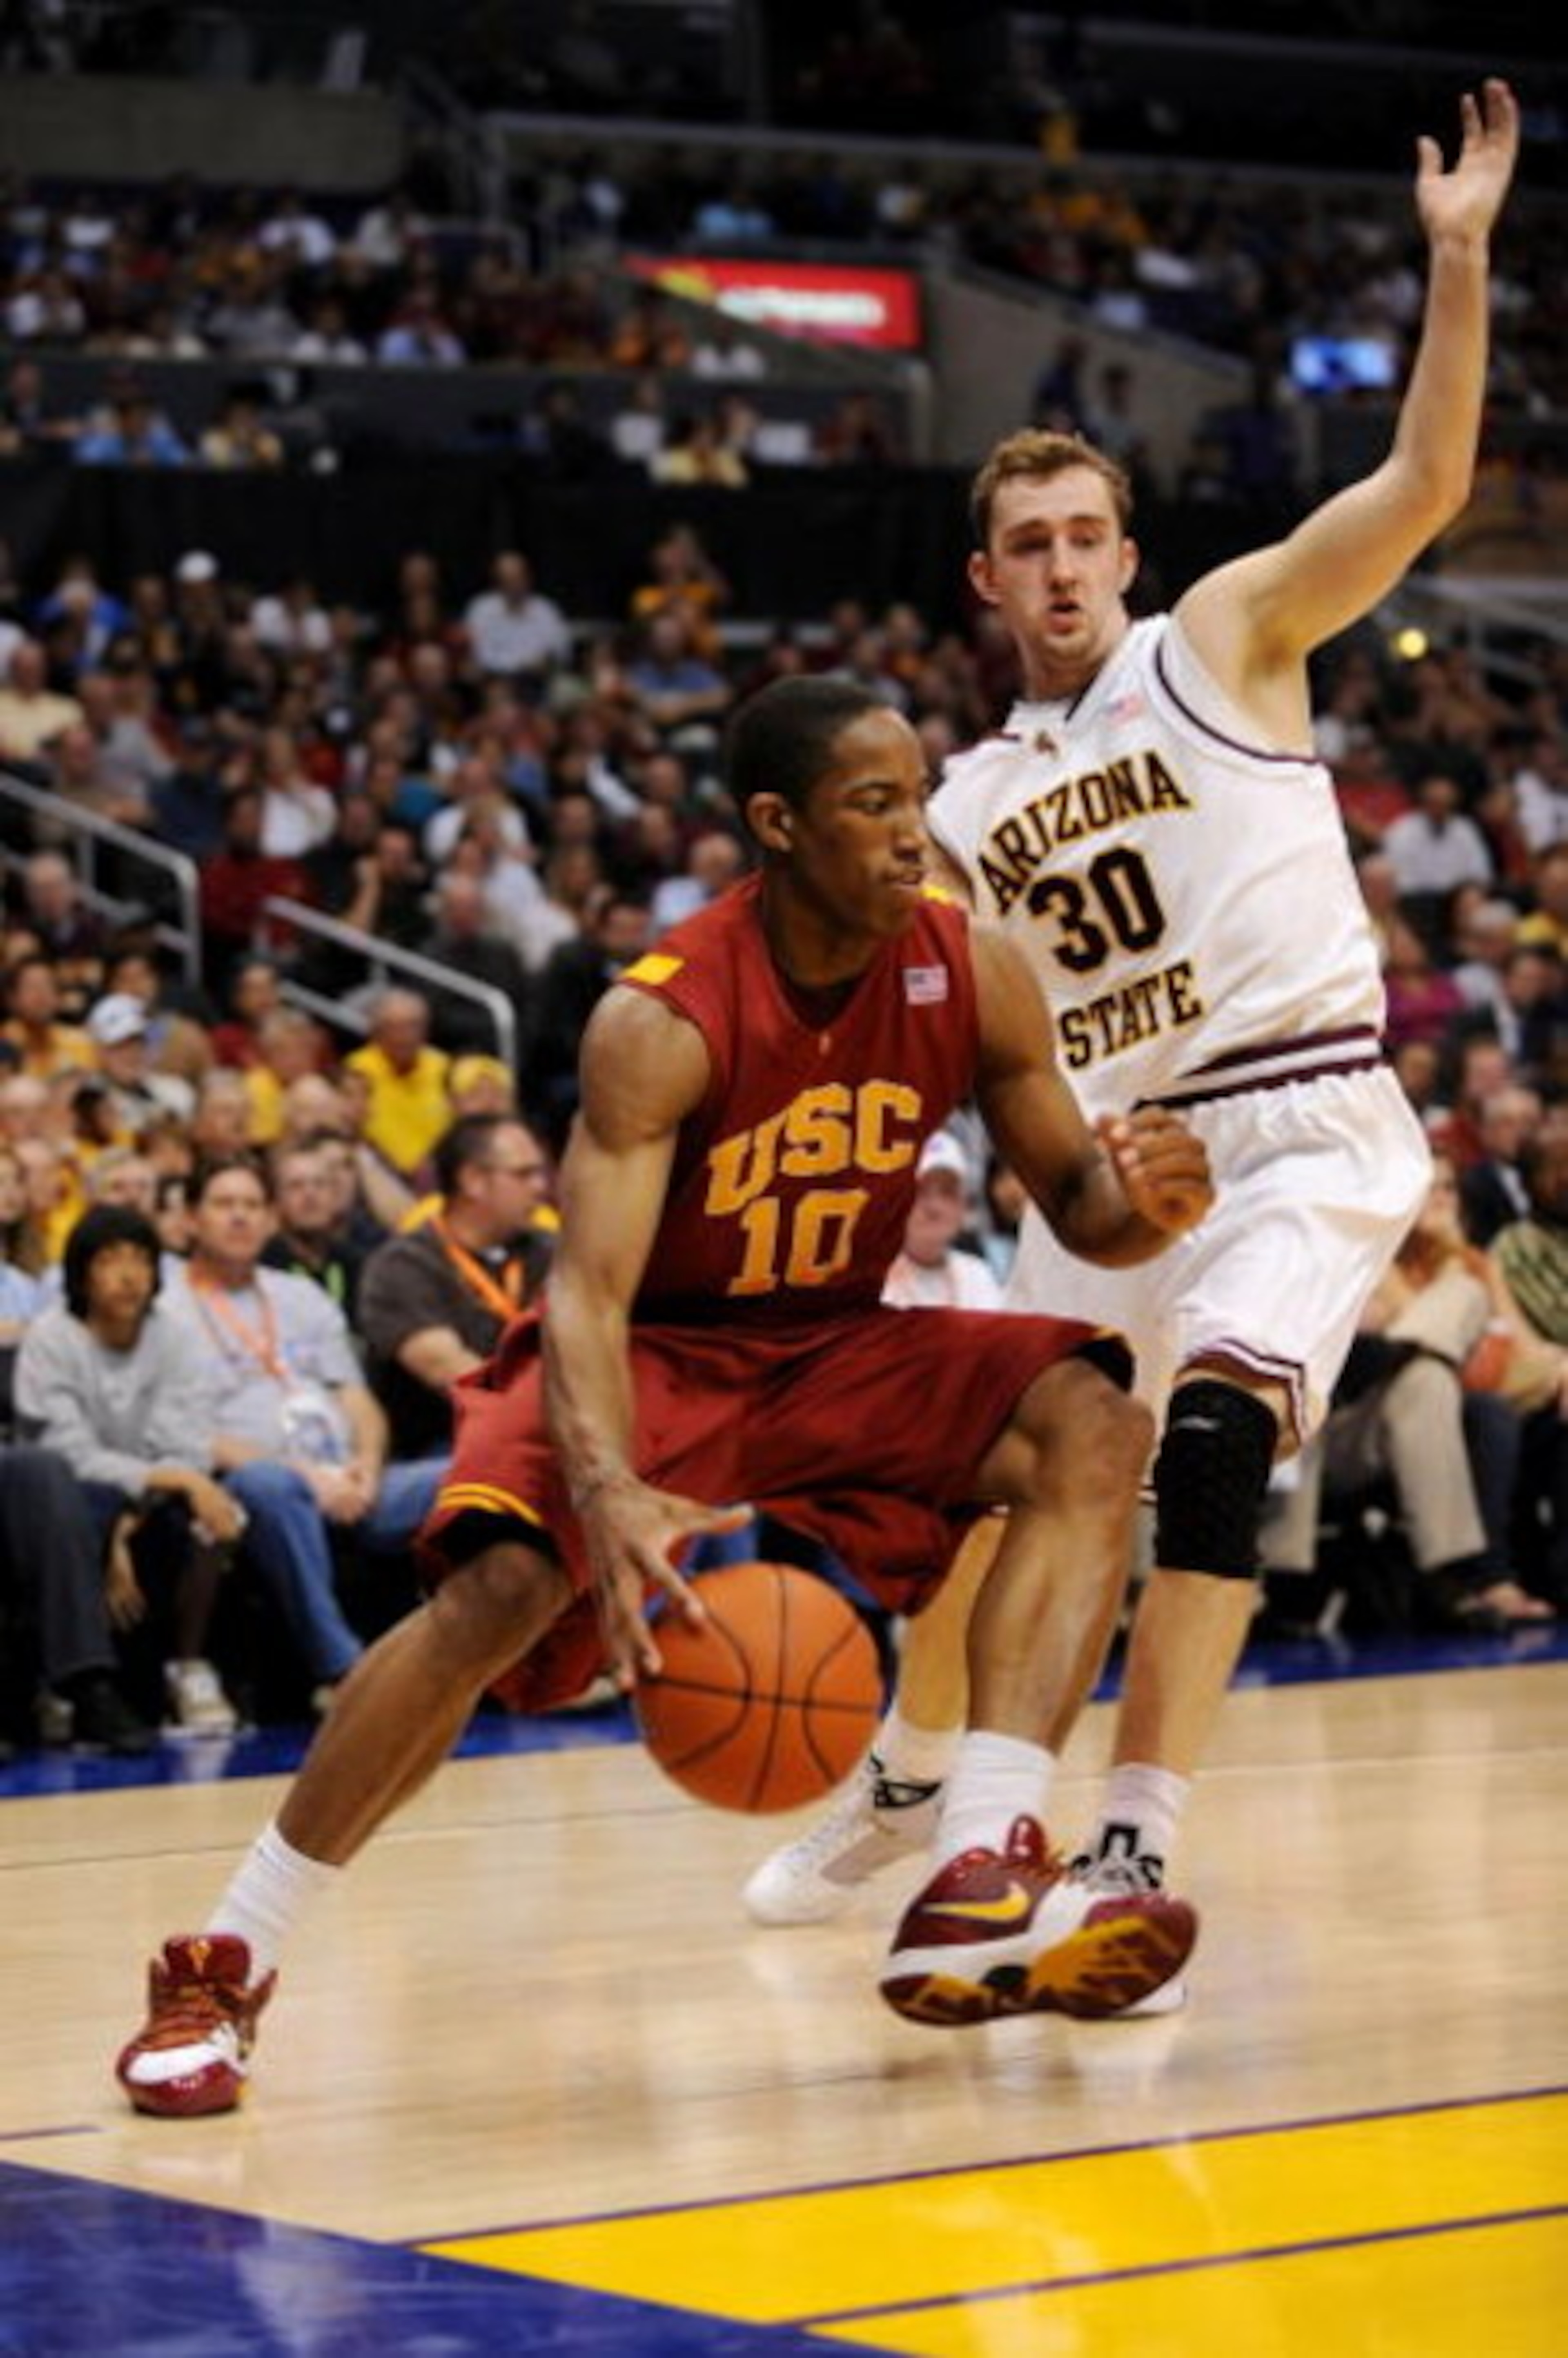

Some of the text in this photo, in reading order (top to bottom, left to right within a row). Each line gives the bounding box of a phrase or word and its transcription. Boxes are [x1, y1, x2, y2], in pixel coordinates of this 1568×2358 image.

[978, 750, 1193, 916] ARIZONA
[1025, 845, 1166, 974] 30
[1059, 961, 1203, 1070] STATE
[704, 1079, 922, 1216] USC
[728, 1189, 870, 1295] 10
